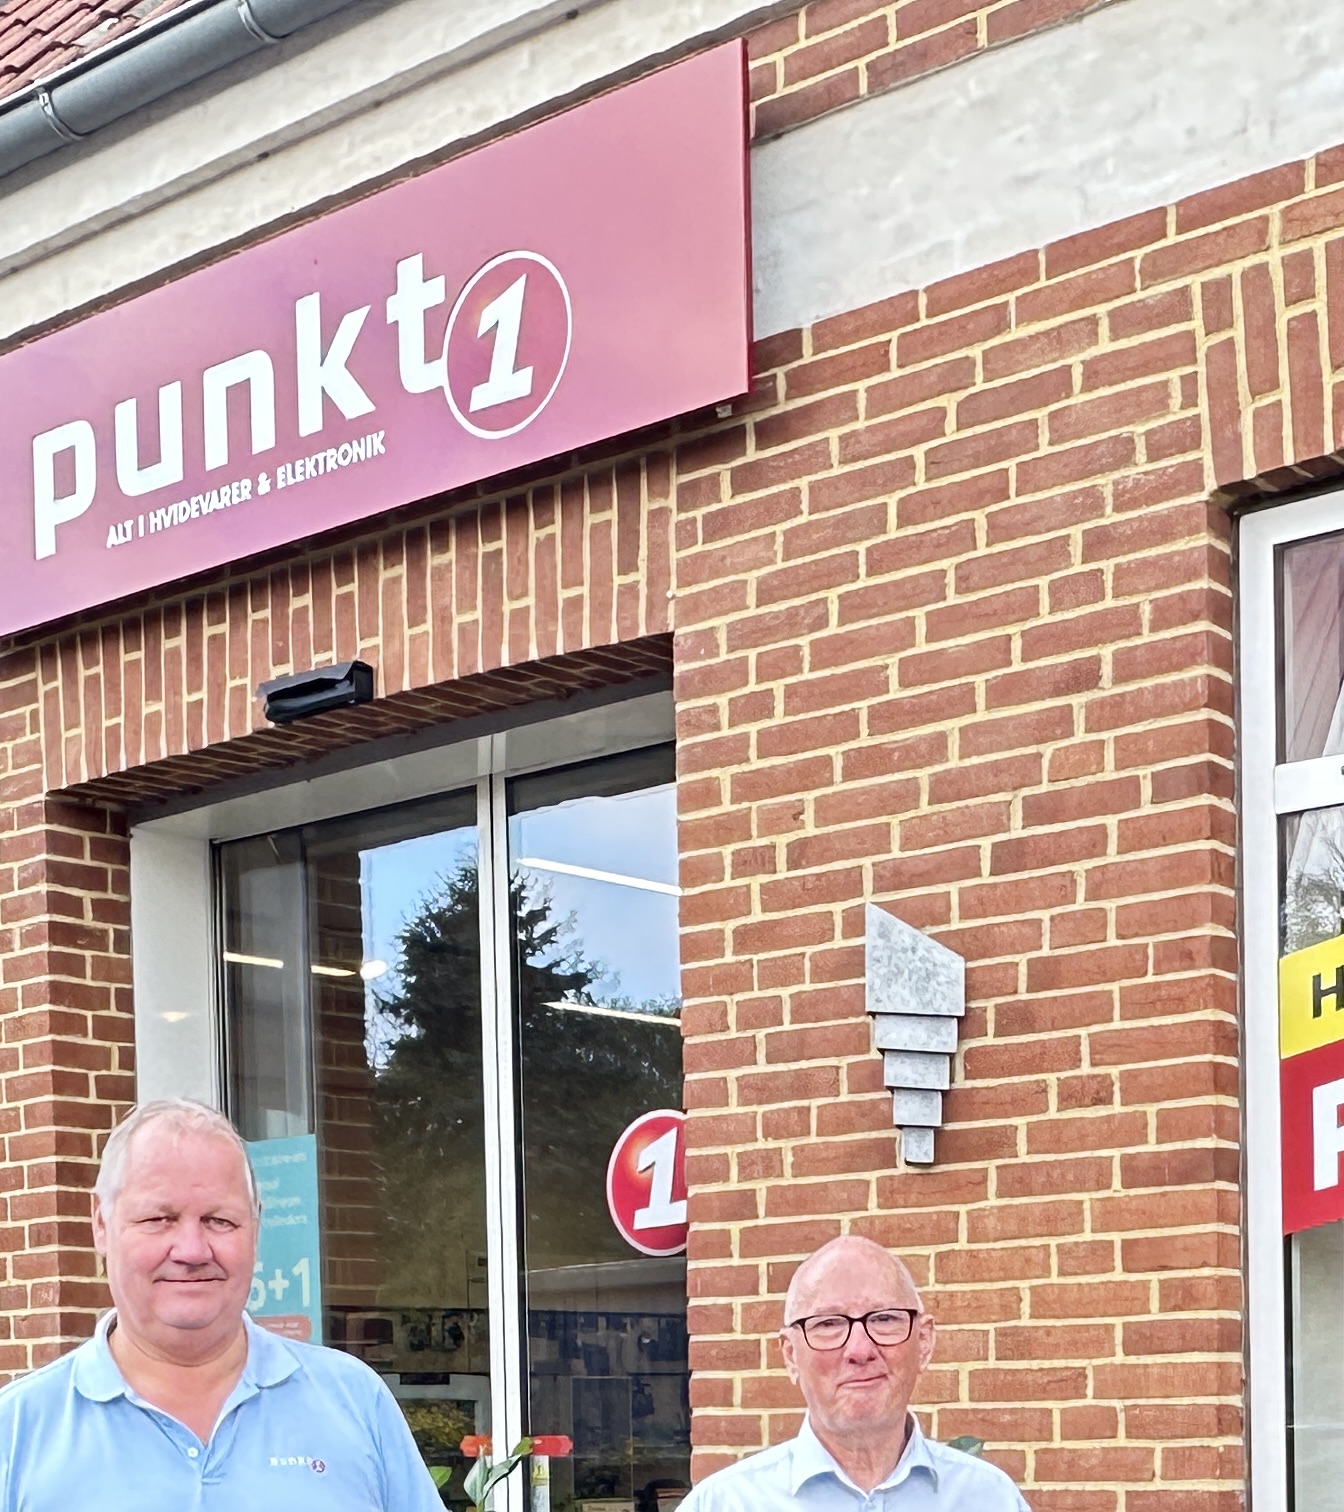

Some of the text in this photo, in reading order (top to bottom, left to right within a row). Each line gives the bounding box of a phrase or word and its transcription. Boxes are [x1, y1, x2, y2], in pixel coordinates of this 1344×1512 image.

[106, 430, 386, 549] ALT I HVIDEVARER & ELEKTRONIK
